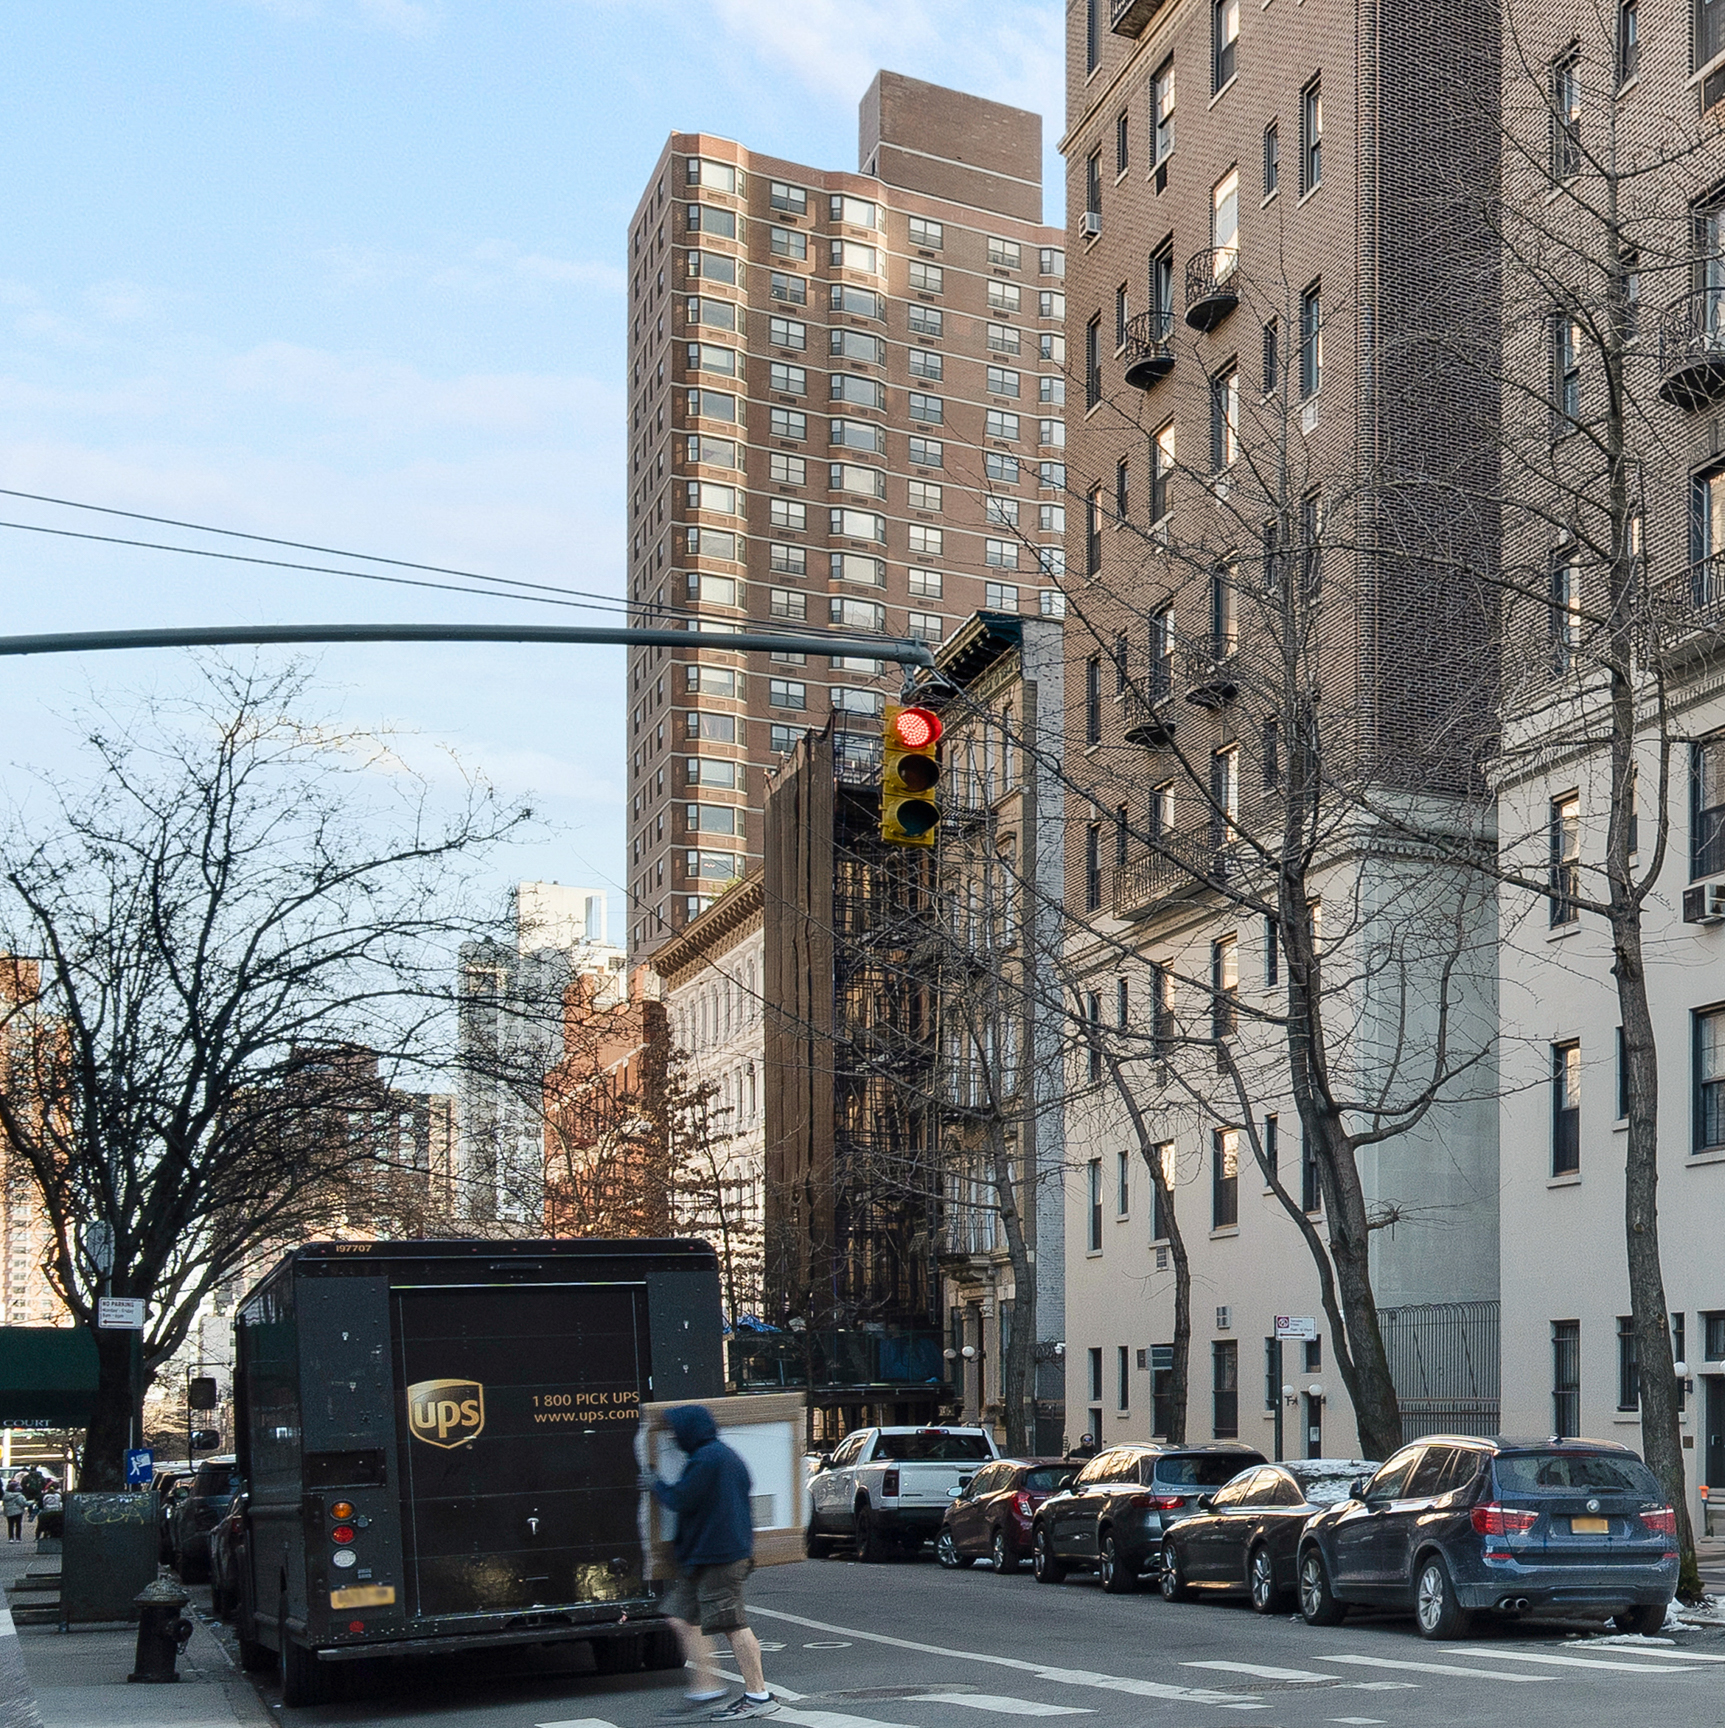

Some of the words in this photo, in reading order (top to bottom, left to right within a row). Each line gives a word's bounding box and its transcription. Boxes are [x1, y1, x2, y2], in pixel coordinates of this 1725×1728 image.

[335, 1244, 372, 1252] 197707
[532, 1395, 539, 1407] 1
[544, 1394, 572, 1407] 800
[576, 1392, 608, 1405] PICK
[613, 1391, 640, 1404] UPS
[414, 1399, 481, 1439] ups
[534, 1409, 640, 1422] www.ups.com
[3, 1419, 52, 1427] COURT
